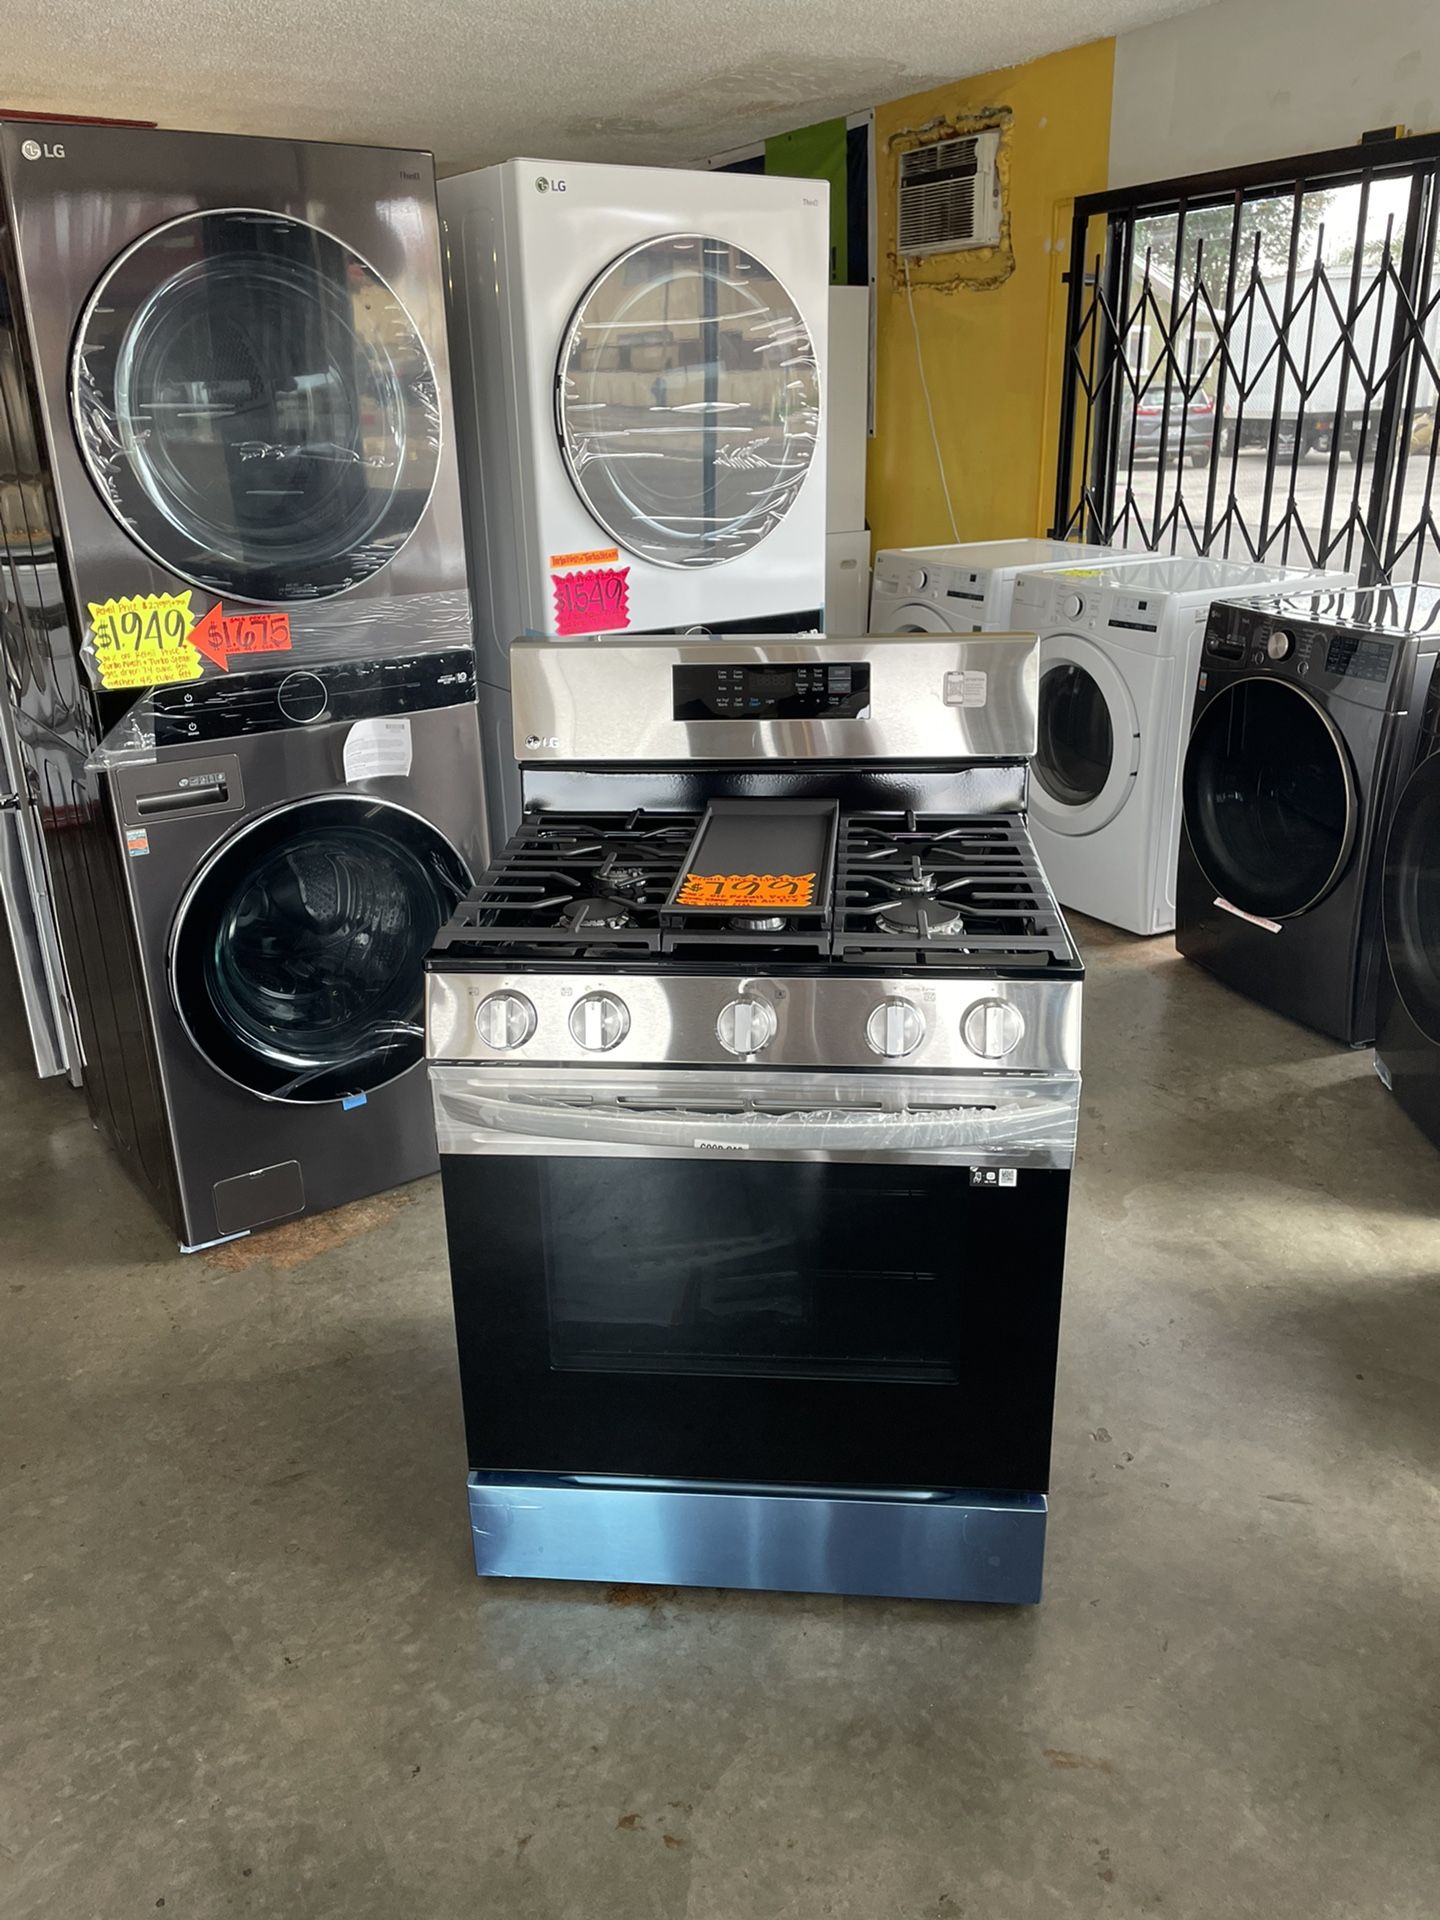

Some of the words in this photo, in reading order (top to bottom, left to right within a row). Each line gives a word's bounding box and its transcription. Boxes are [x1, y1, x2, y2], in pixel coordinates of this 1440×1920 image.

[43, 143, 66, 158] LG
[551, 180, 567, 192] LG
[542, 736, 560, 749] LG
[690, 880, 799, 896] $799
